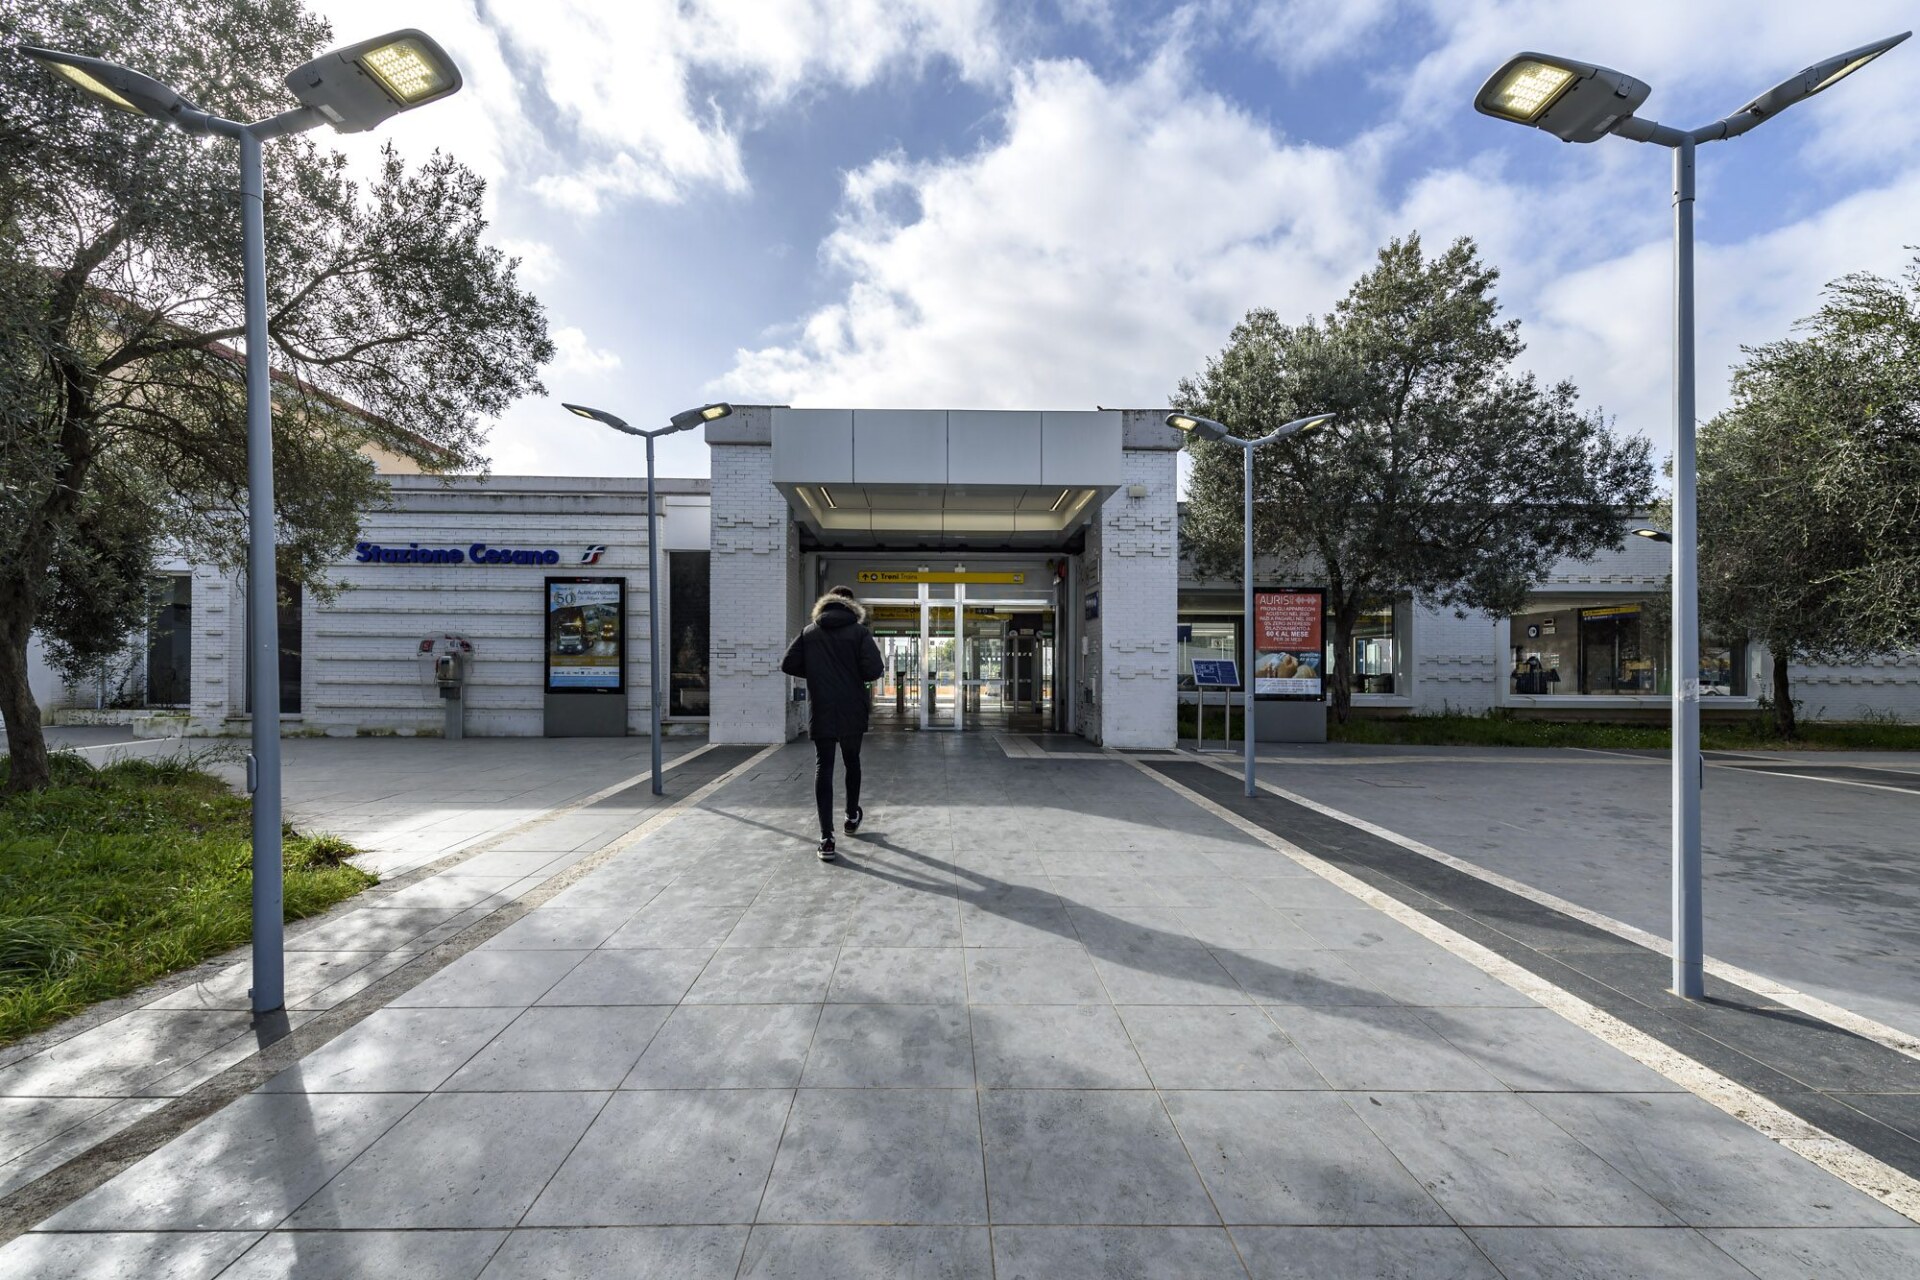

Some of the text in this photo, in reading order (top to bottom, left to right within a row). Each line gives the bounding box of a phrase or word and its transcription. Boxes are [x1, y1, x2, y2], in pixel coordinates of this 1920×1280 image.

[356, 542, 560, 564] Stazione Cesano
[557, 593, 574, 604] 50
[1260, 595, 1290, 605] AURIS
